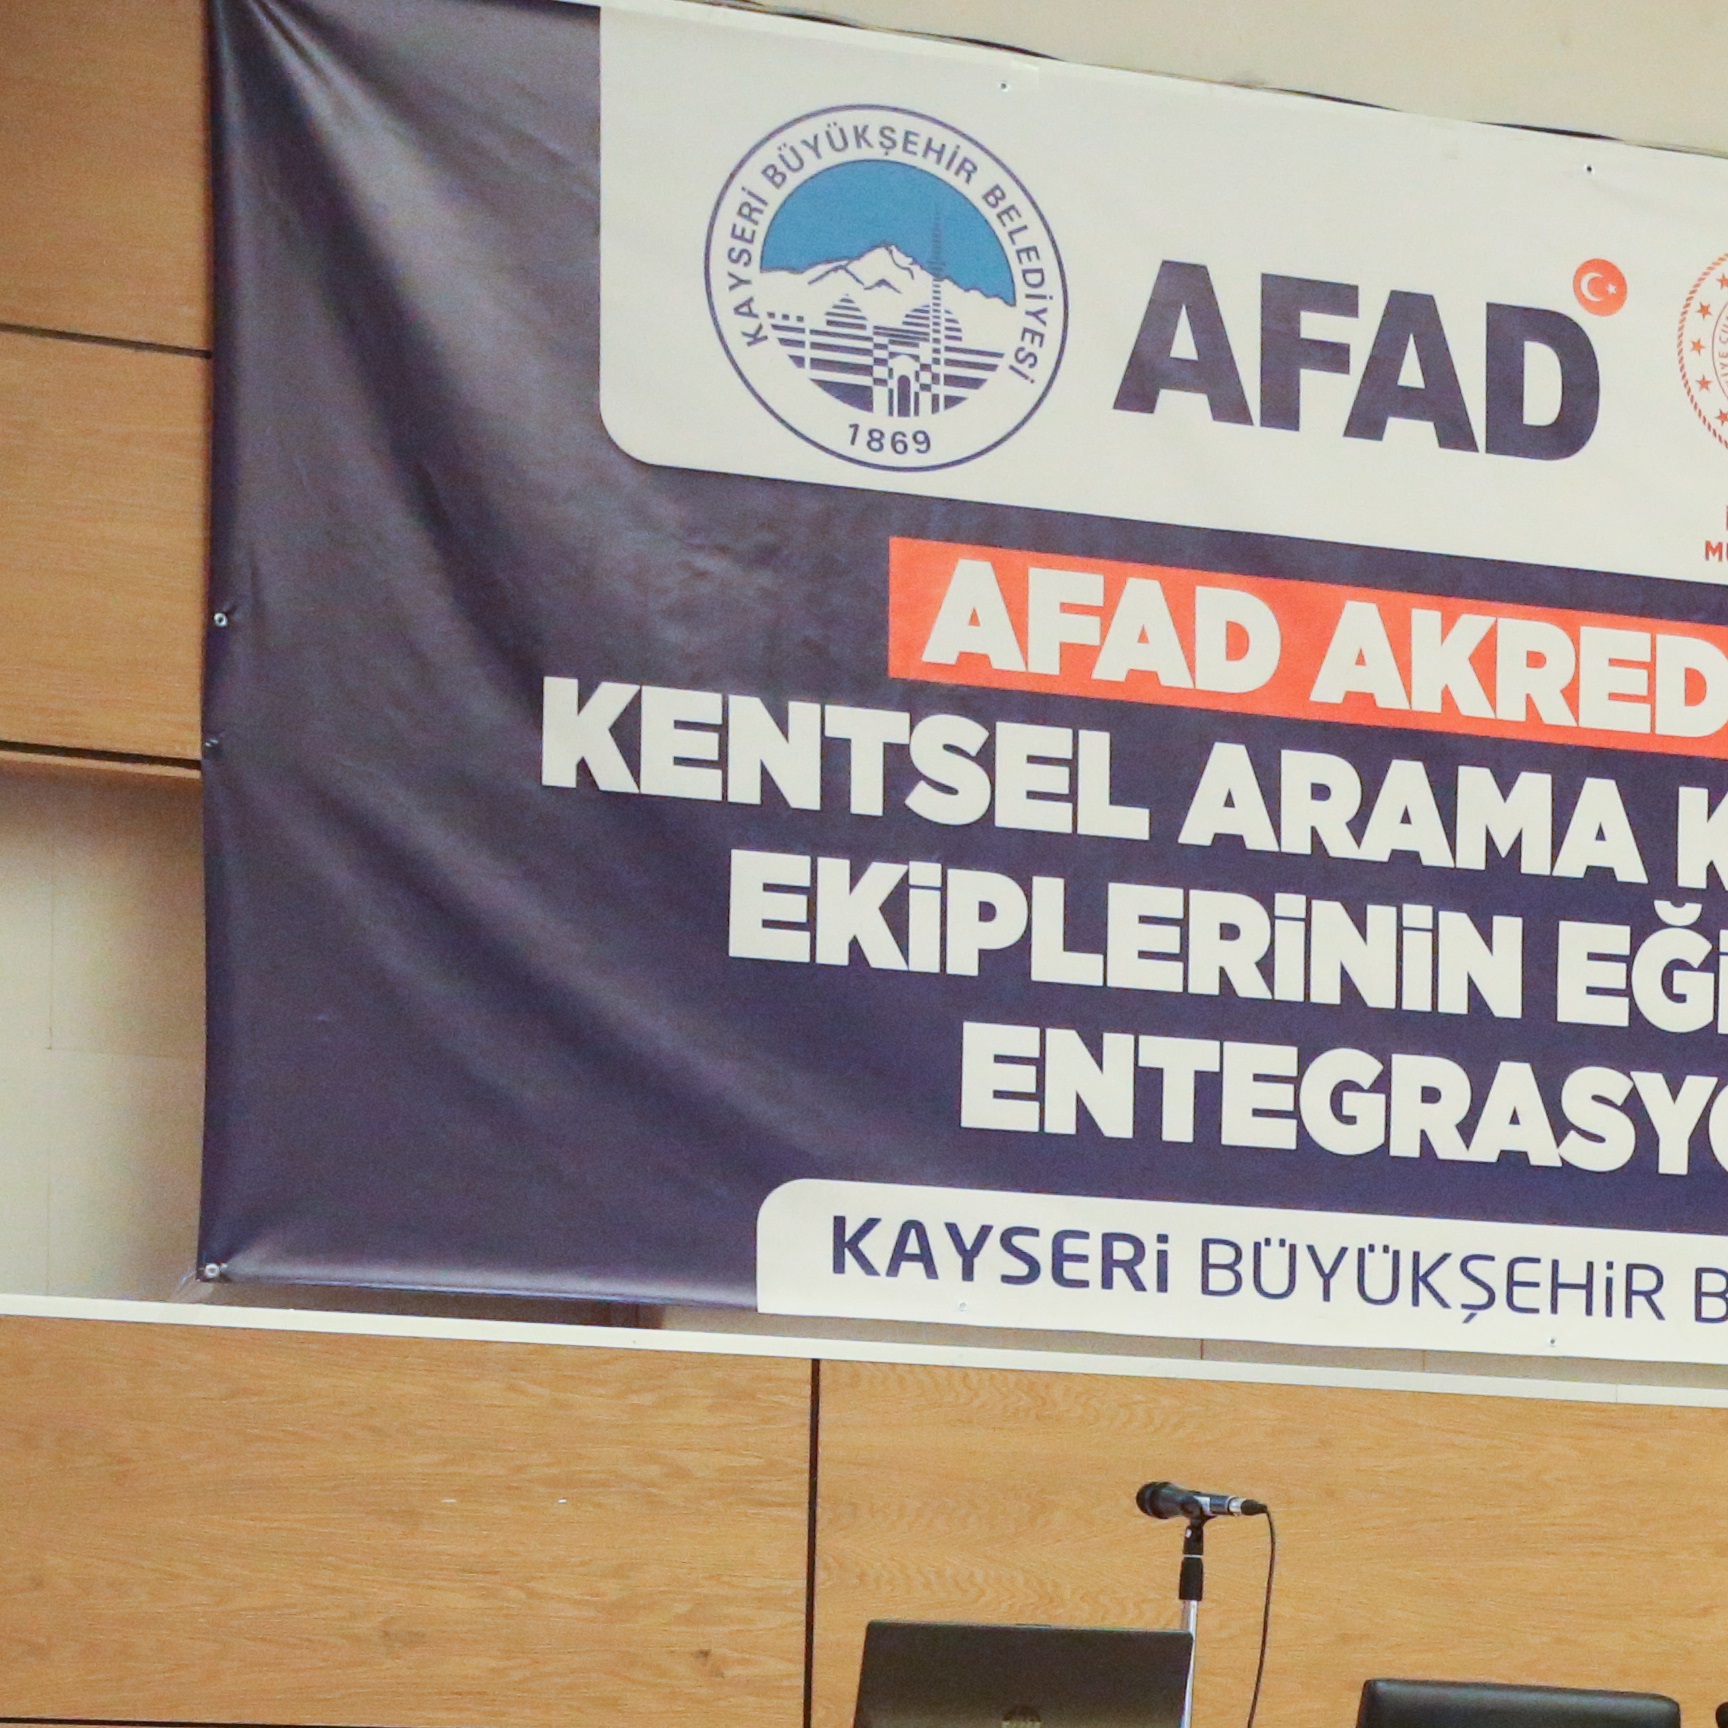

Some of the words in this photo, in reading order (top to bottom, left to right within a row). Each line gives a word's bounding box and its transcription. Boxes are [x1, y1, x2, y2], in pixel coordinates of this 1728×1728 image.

[728, 186, 770, 346] KAYSERİ
[761, 121, 979, 190] BÜYÜKŞEHİR
[982, 184, 1054, 384] BELEDİYESİ
[848, 424, 932, 455] 1869
[1113, 260, 1600, 461] AFAD
[922, 558, 1282, 694] AFAD
[541, 676, 1150, 841] KENTSEL
[1177, 741, 1649, 884] ARAMA
